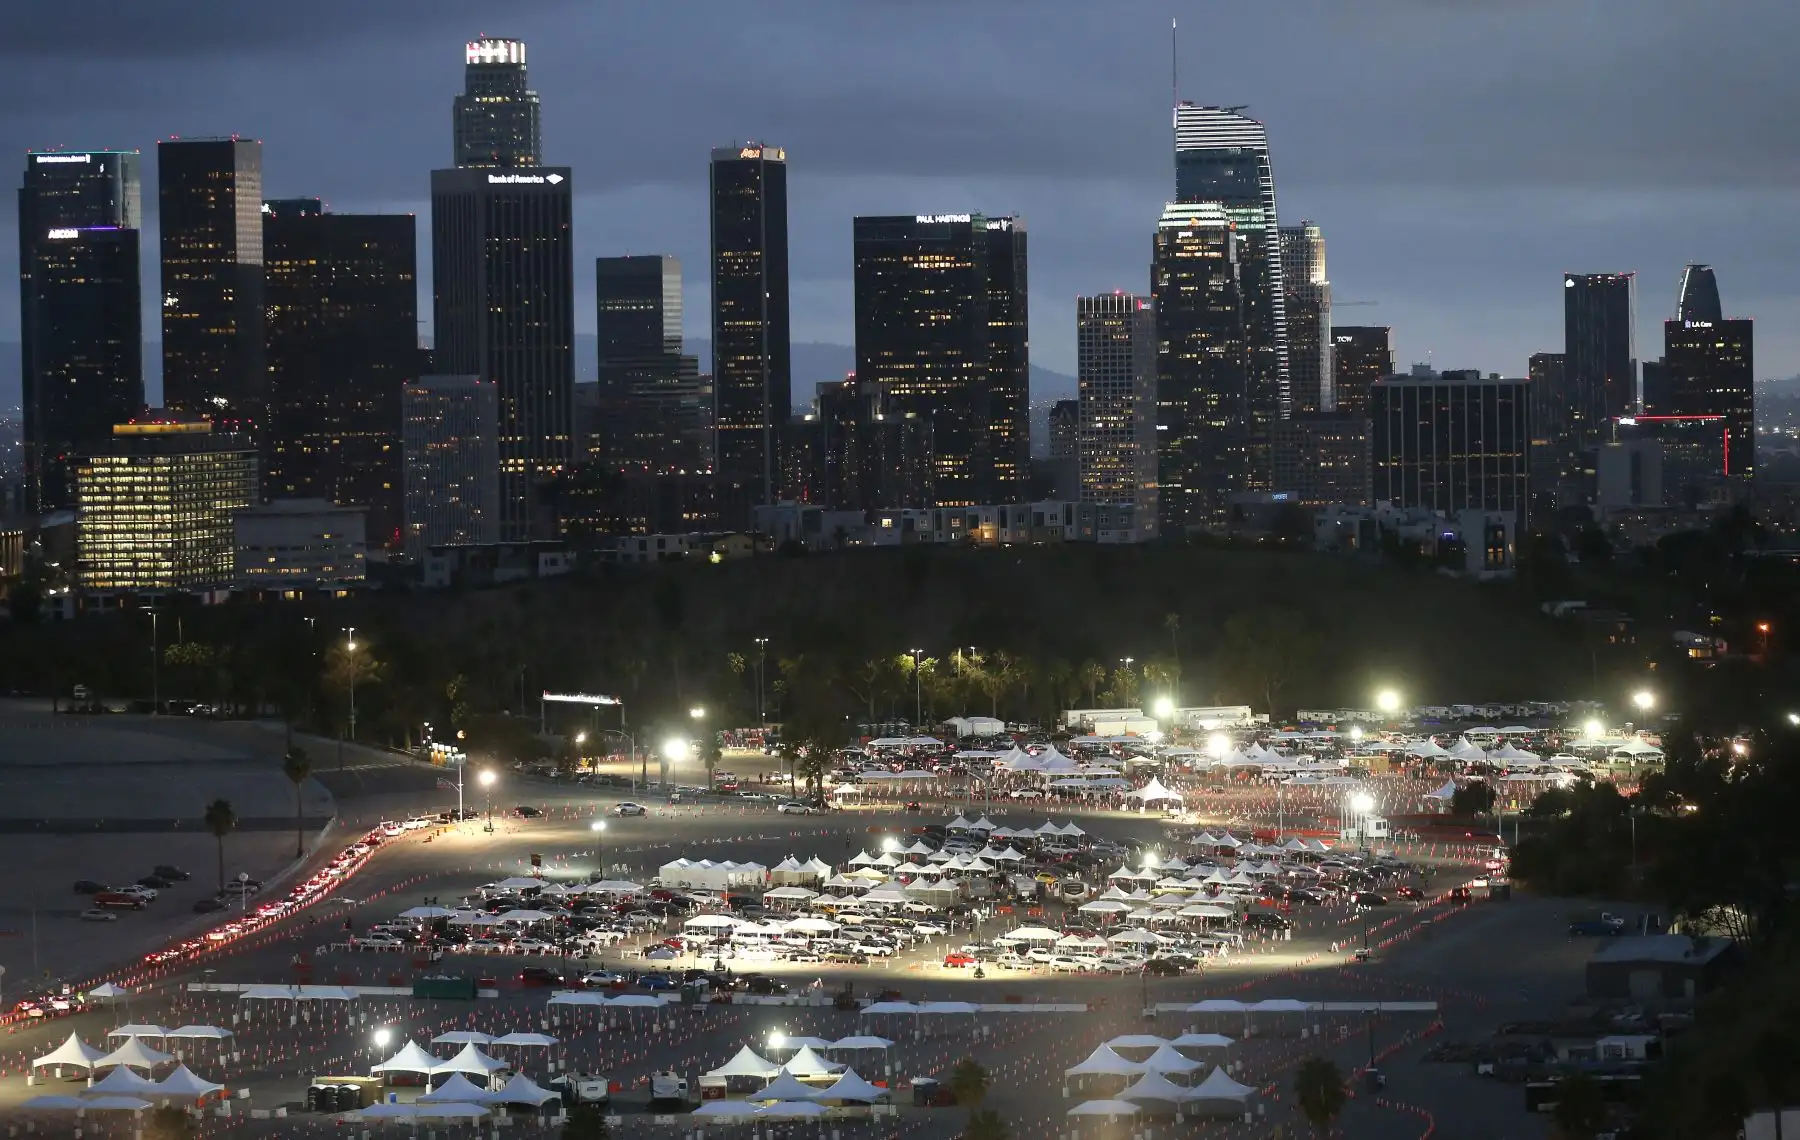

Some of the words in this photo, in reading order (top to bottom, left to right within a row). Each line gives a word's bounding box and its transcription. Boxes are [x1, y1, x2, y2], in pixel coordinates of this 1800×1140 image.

[488, 174, 507, 183] Bank
[507, 174, 515, 183] of
[515, 174, 545, 183] America
[916, 215, 934, 223] PAUL
[935, 214, 970, 222] HASTINGS
